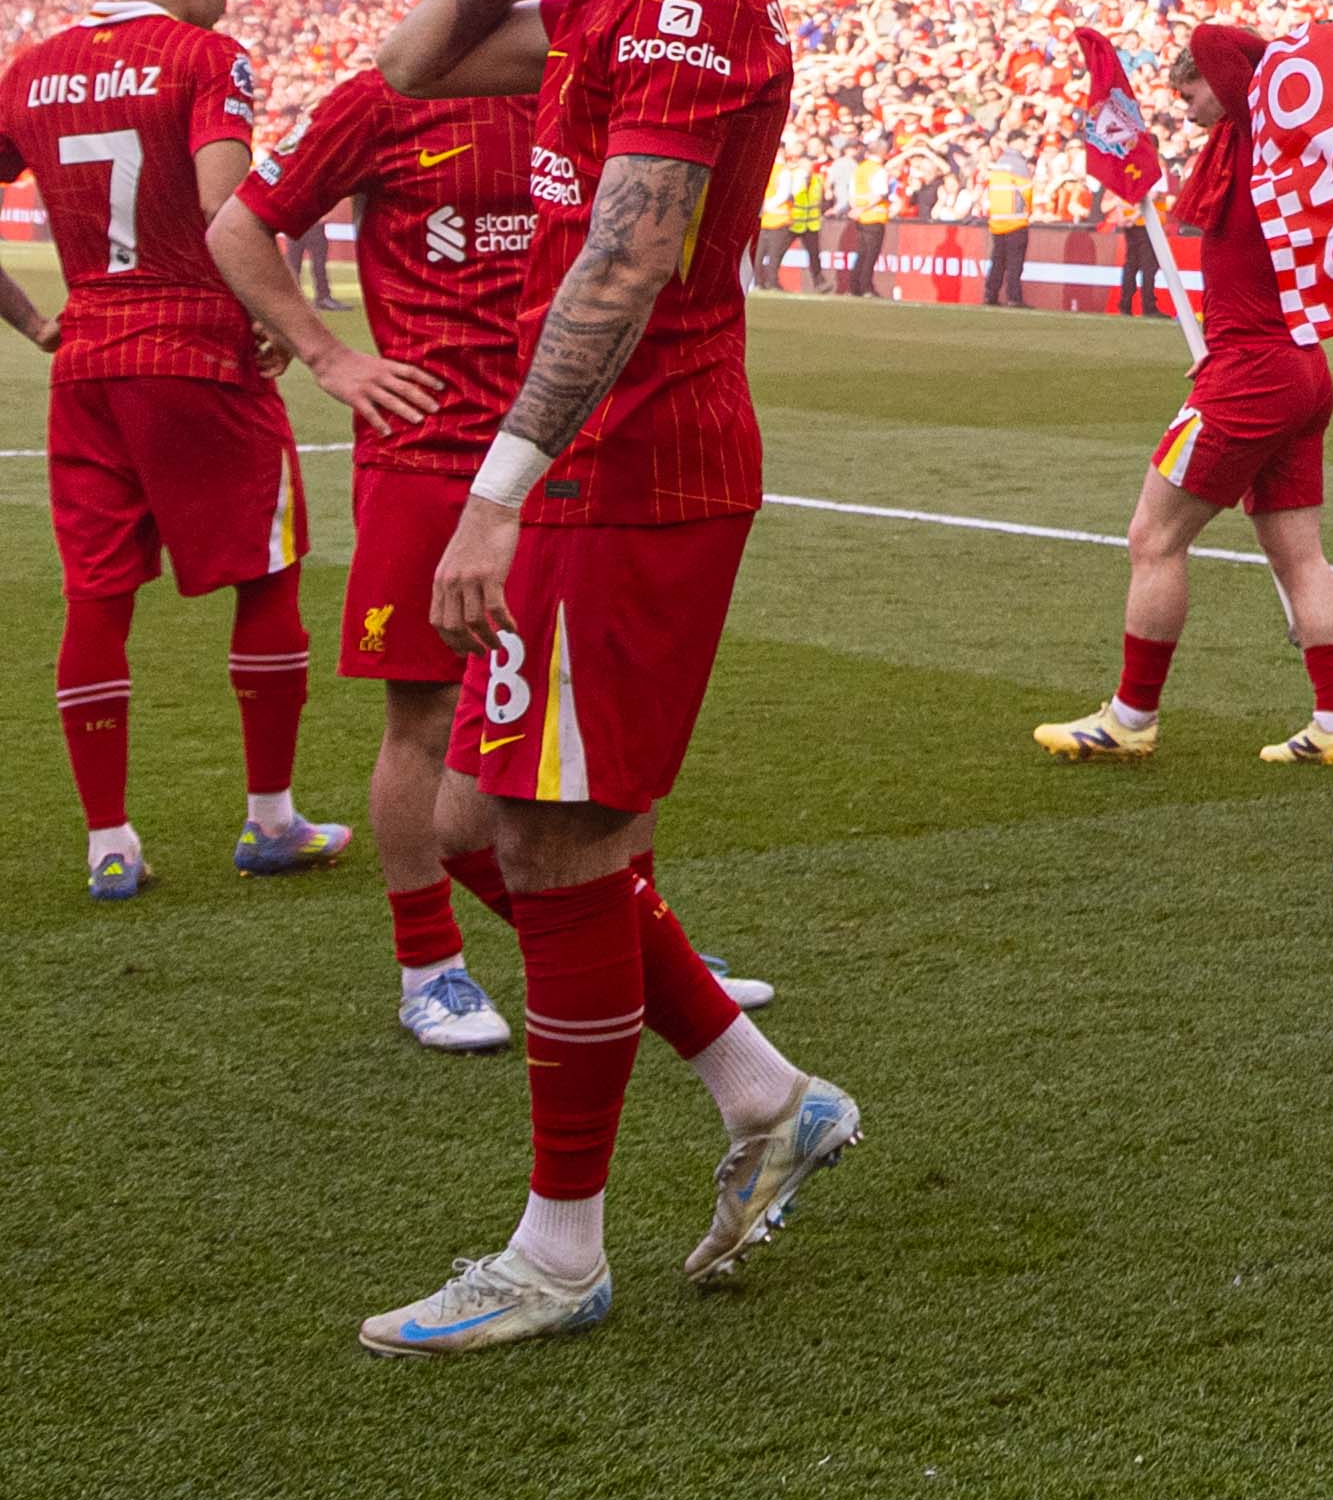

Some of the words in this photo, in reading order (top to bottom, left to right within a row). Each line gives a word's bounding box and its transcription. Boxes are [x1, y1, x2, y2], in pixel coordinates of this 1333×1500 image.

[27, 74, 87, 107] LUIS
[95, 59, 161, 102] DÍAZ
[618, 35, 731, 76] Expedia
[58, 128, 143, 274] 7
[485, 629, 532, 724] 8
